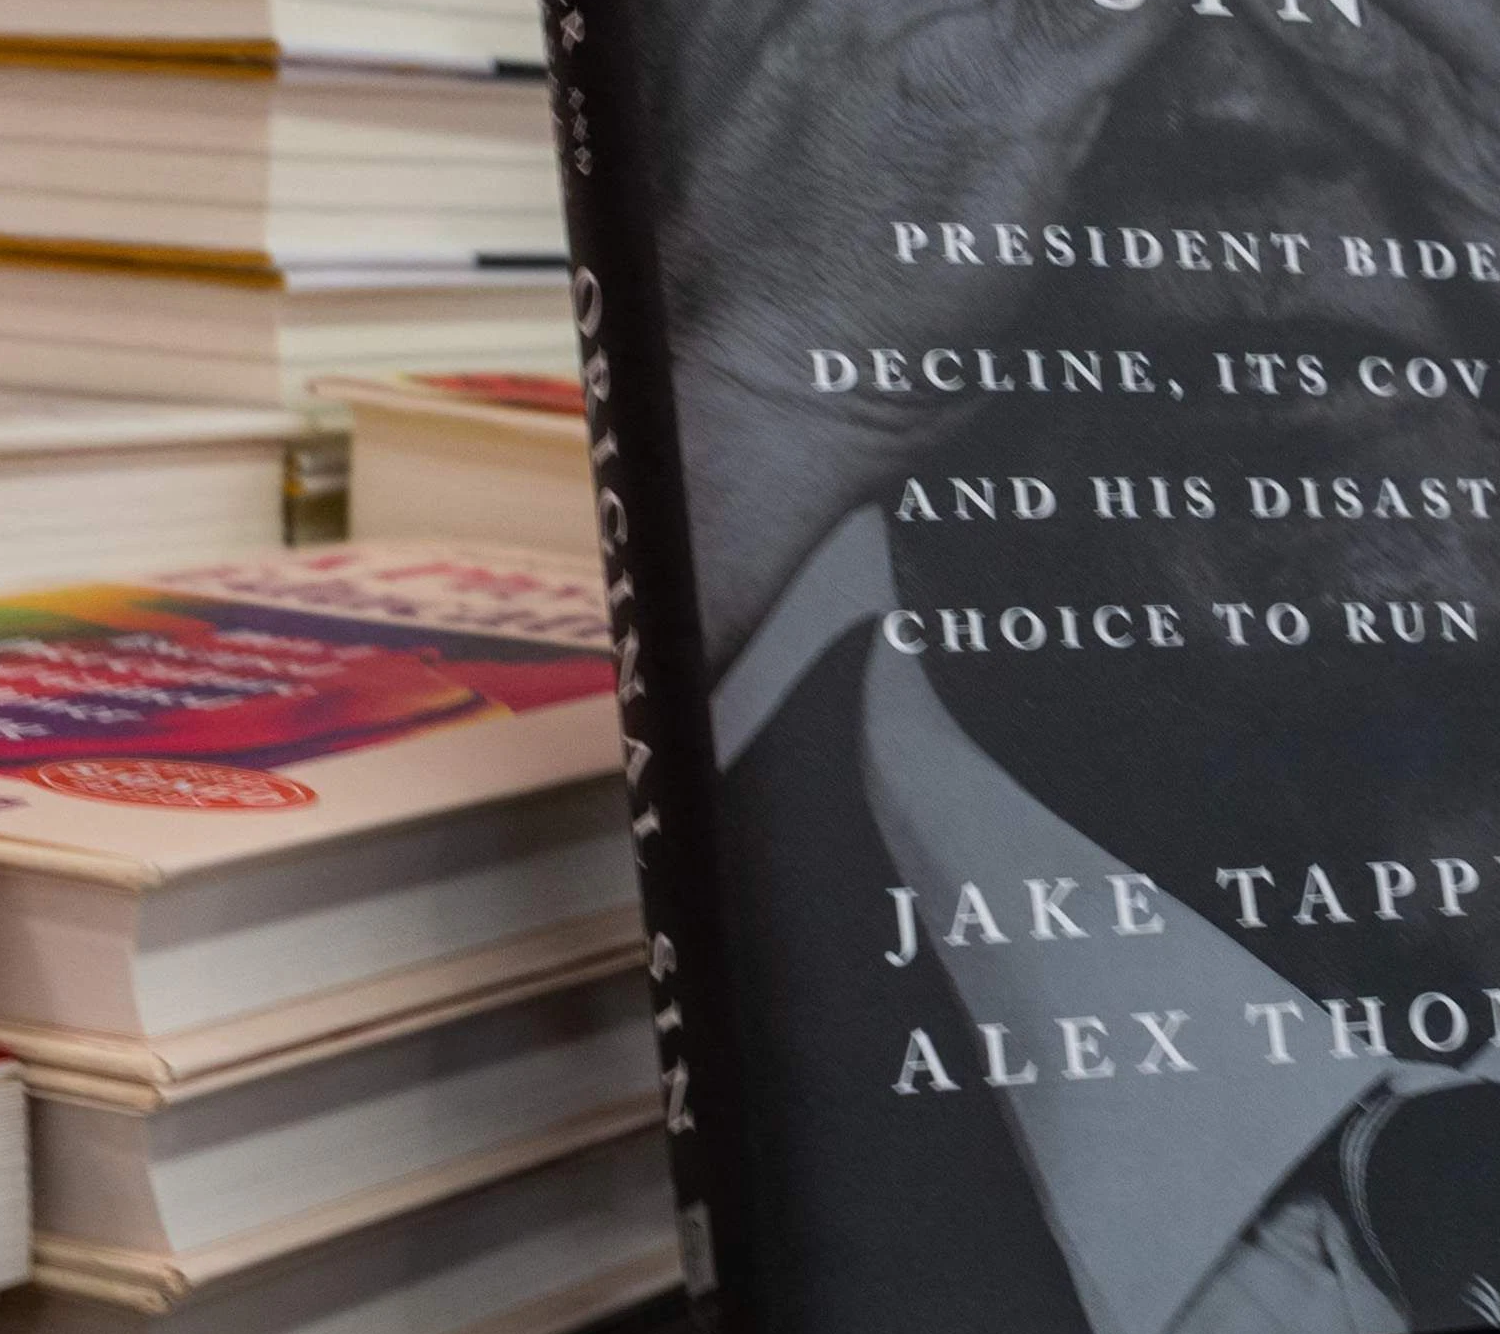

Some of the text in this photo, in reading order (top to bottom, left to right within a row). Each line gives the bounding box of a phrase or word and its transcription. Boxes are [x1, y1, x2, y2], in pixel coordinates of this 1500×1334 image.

[892, 219, 1311, 275] PRESIDENT
[808, 347, 1186, 402] DECLINE,
[1212, 350, 1328, 397] ITS
[894, 475, 1059, 523] AND
[1093, 474, 1217, 521] HIS
[882, 602, 1186, 657] CHOICE
[1212, 600, 1311, 648] TO
[1343, 598, 1481, 646] RUN
[884, 870, 1166, 967] JAKE
[891, 1005, 1197, 1095] ALEX
